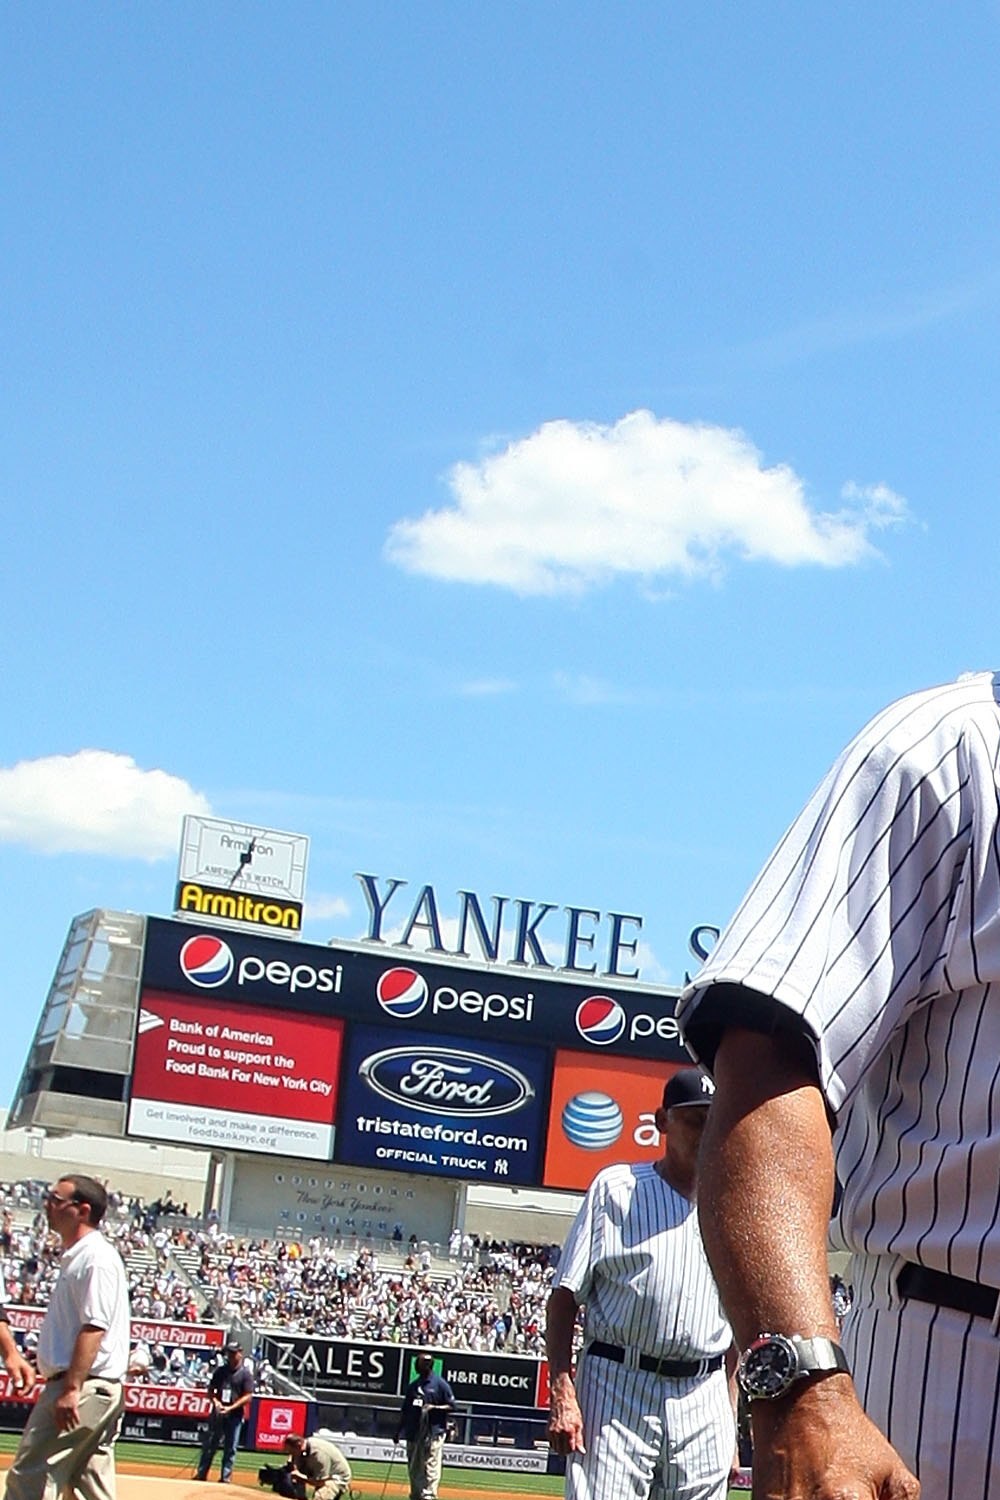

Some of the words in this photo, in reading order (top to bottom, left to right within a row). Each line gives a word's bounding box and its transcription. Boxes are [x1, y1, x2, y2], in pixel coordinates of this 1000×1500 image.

[220, 835, 273, 855] Armiron
[255, 874, 283, 886] WATCH
[181, 884, 299, 928] Armitron
[354, 872, 643, 979] YANKEE
[238, 957, 343, 993] pepsi
[433, 985, 534, 1021] pepsi
[169, 1018, 202, 1035] Bank
[205, 1024, 219, 1037] of
[220, 1027, 273, 1046] America
[630, 1014, 684, 1046] pe
[168, 1039, 205, 1057] Proud
[208, 1045, 221, 1058] to
[223, 1048, 271, 1069] support
[274, 1056, 294, 1069] the
[165, 1059, 195, 1075] Food
[198, 1063, 229, 1080] Bank
[231, 1069, 251, 1083] For
[253, 1072, 280, 1087] New
[282, 1076, 308, 1091] York
[309, 1080, 332, 1096] City
[400, 1059, 494, 1105] Ford
[146, 1108, 164, 1119] Get
[166, 1112, 206, 1125] involved
[209, 1118, 227, 1128] and
[229, 1120, 258, 1132] make
[260, 1125, 266, 1133] a
[356, 1117, 527, 1151] tristateford.com
[188, 1126, 276, 1147] foodbanknyc.org
[376, 1147, 437, 1164] OFFICIAL
[441, 1156, 487, 1170] TRUCK
[277, 1343, 384, 1378] ZALES
[447, 1369, 477, 1384] H&R
[482, 1374, 529, 1389] BLOCK
[125, 1427, 144, 1436] BALL
[172, 1430, 199, 1440] STRIKE
